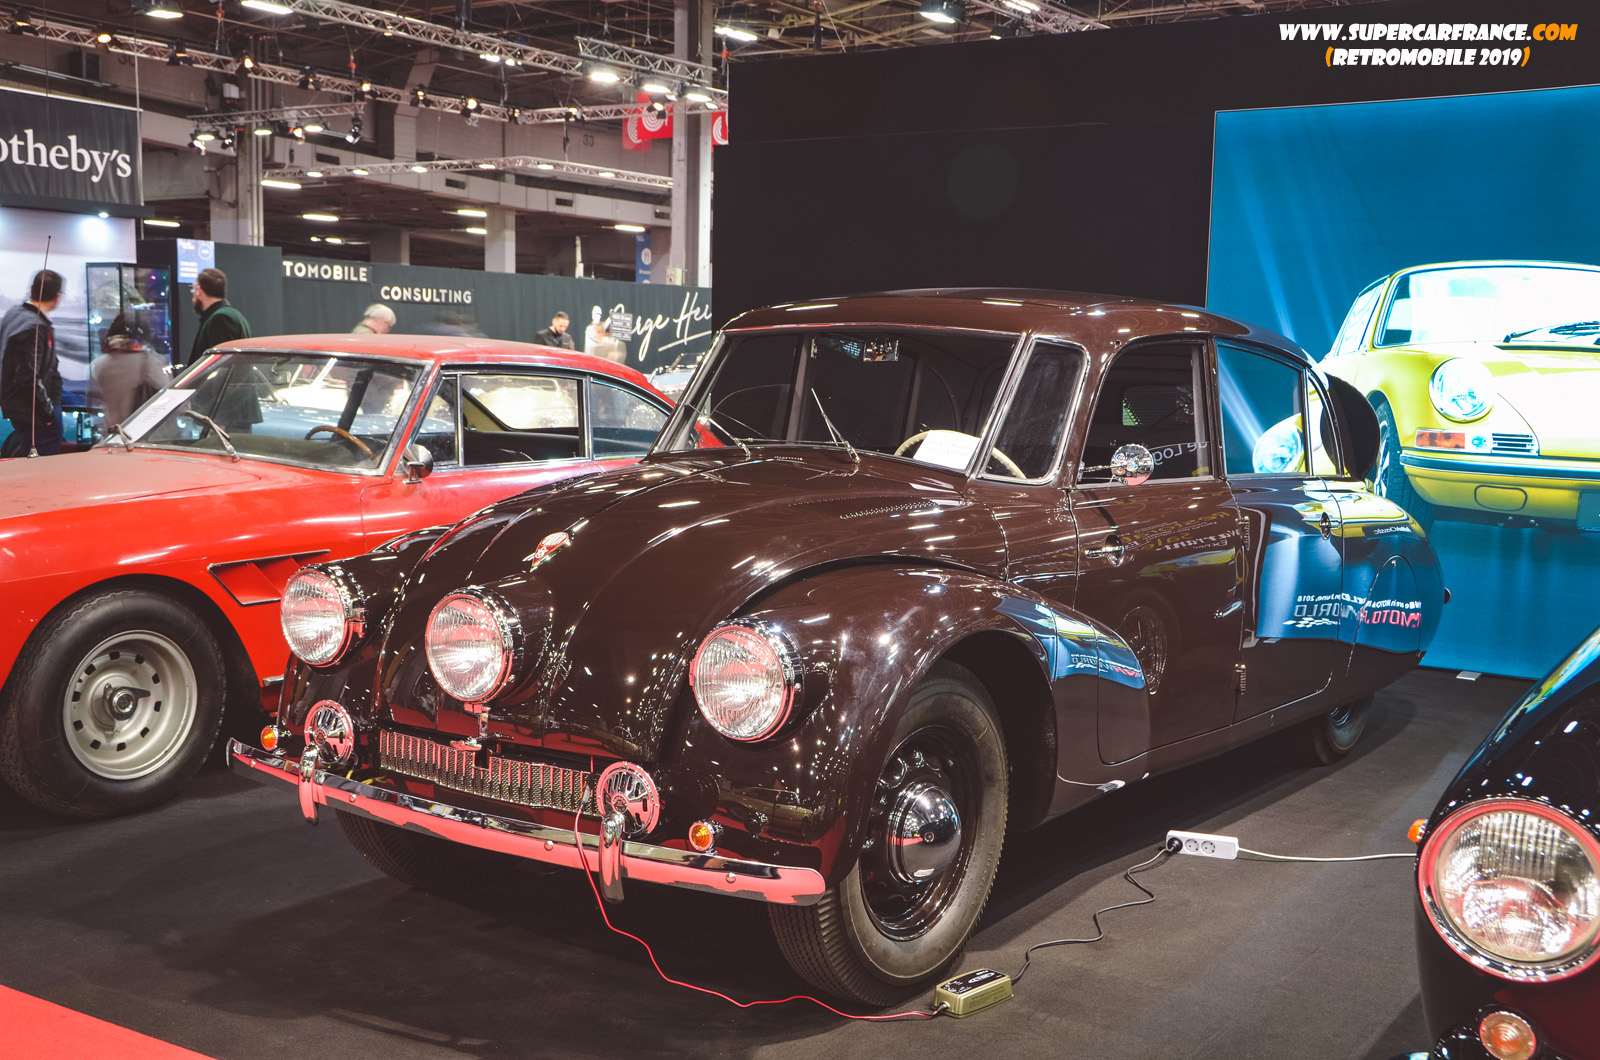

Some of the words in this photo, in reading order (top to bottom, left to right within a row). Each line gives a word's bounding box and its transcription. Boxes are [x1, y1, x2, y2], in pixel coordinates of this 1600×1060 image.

[583, 133, 595, 147] 33
[282, 260, 368, 282] TOMOBILE
[380, 285, 472, 304] CONSULTING
